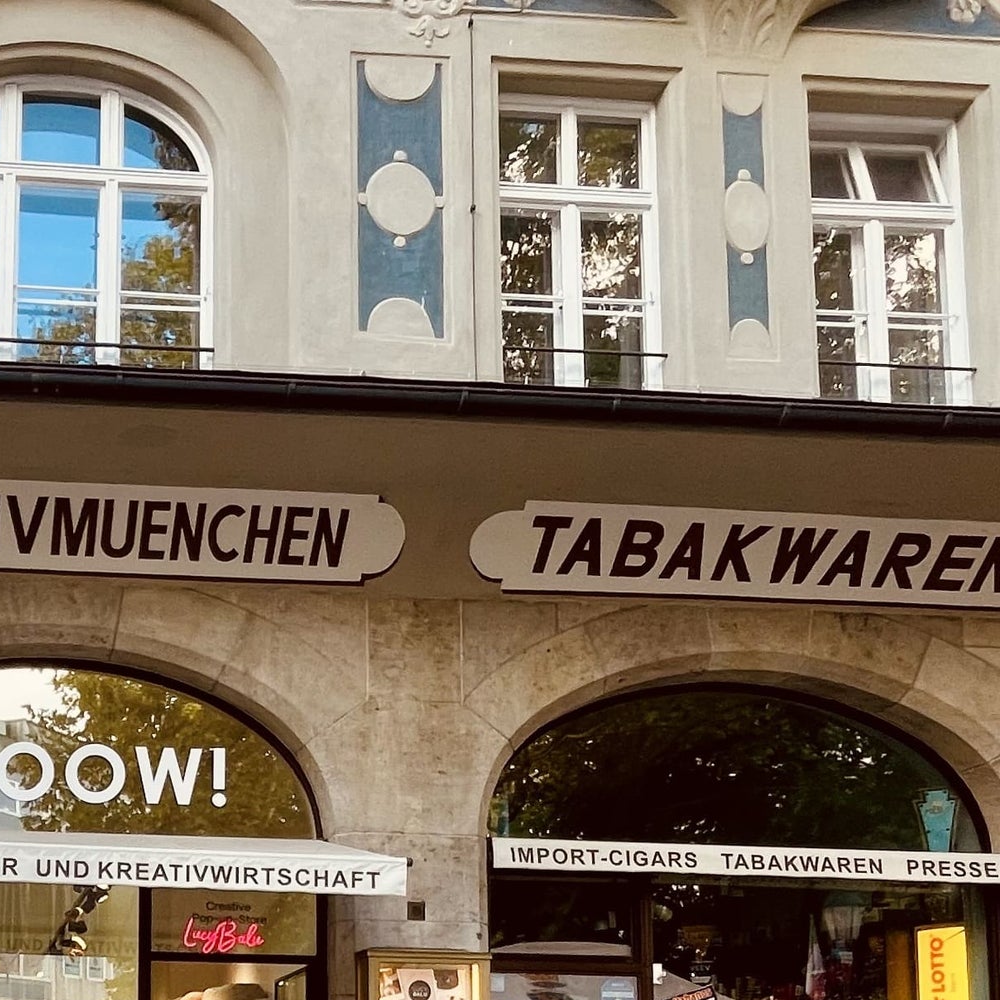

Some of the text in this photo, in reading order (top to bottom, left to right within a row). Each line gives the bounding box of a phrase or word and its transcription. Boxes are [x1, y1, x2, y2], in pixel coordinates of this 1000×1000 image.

[36, 859, 89, 879] UND
[98, 862, 381, 890] KREATIVWIRTSCHAFT
[510, 847, 999, 878] IMPORT-CIGARS TABAKWAREN PRESSE
[930, 936, 945, 993] LOTTO
